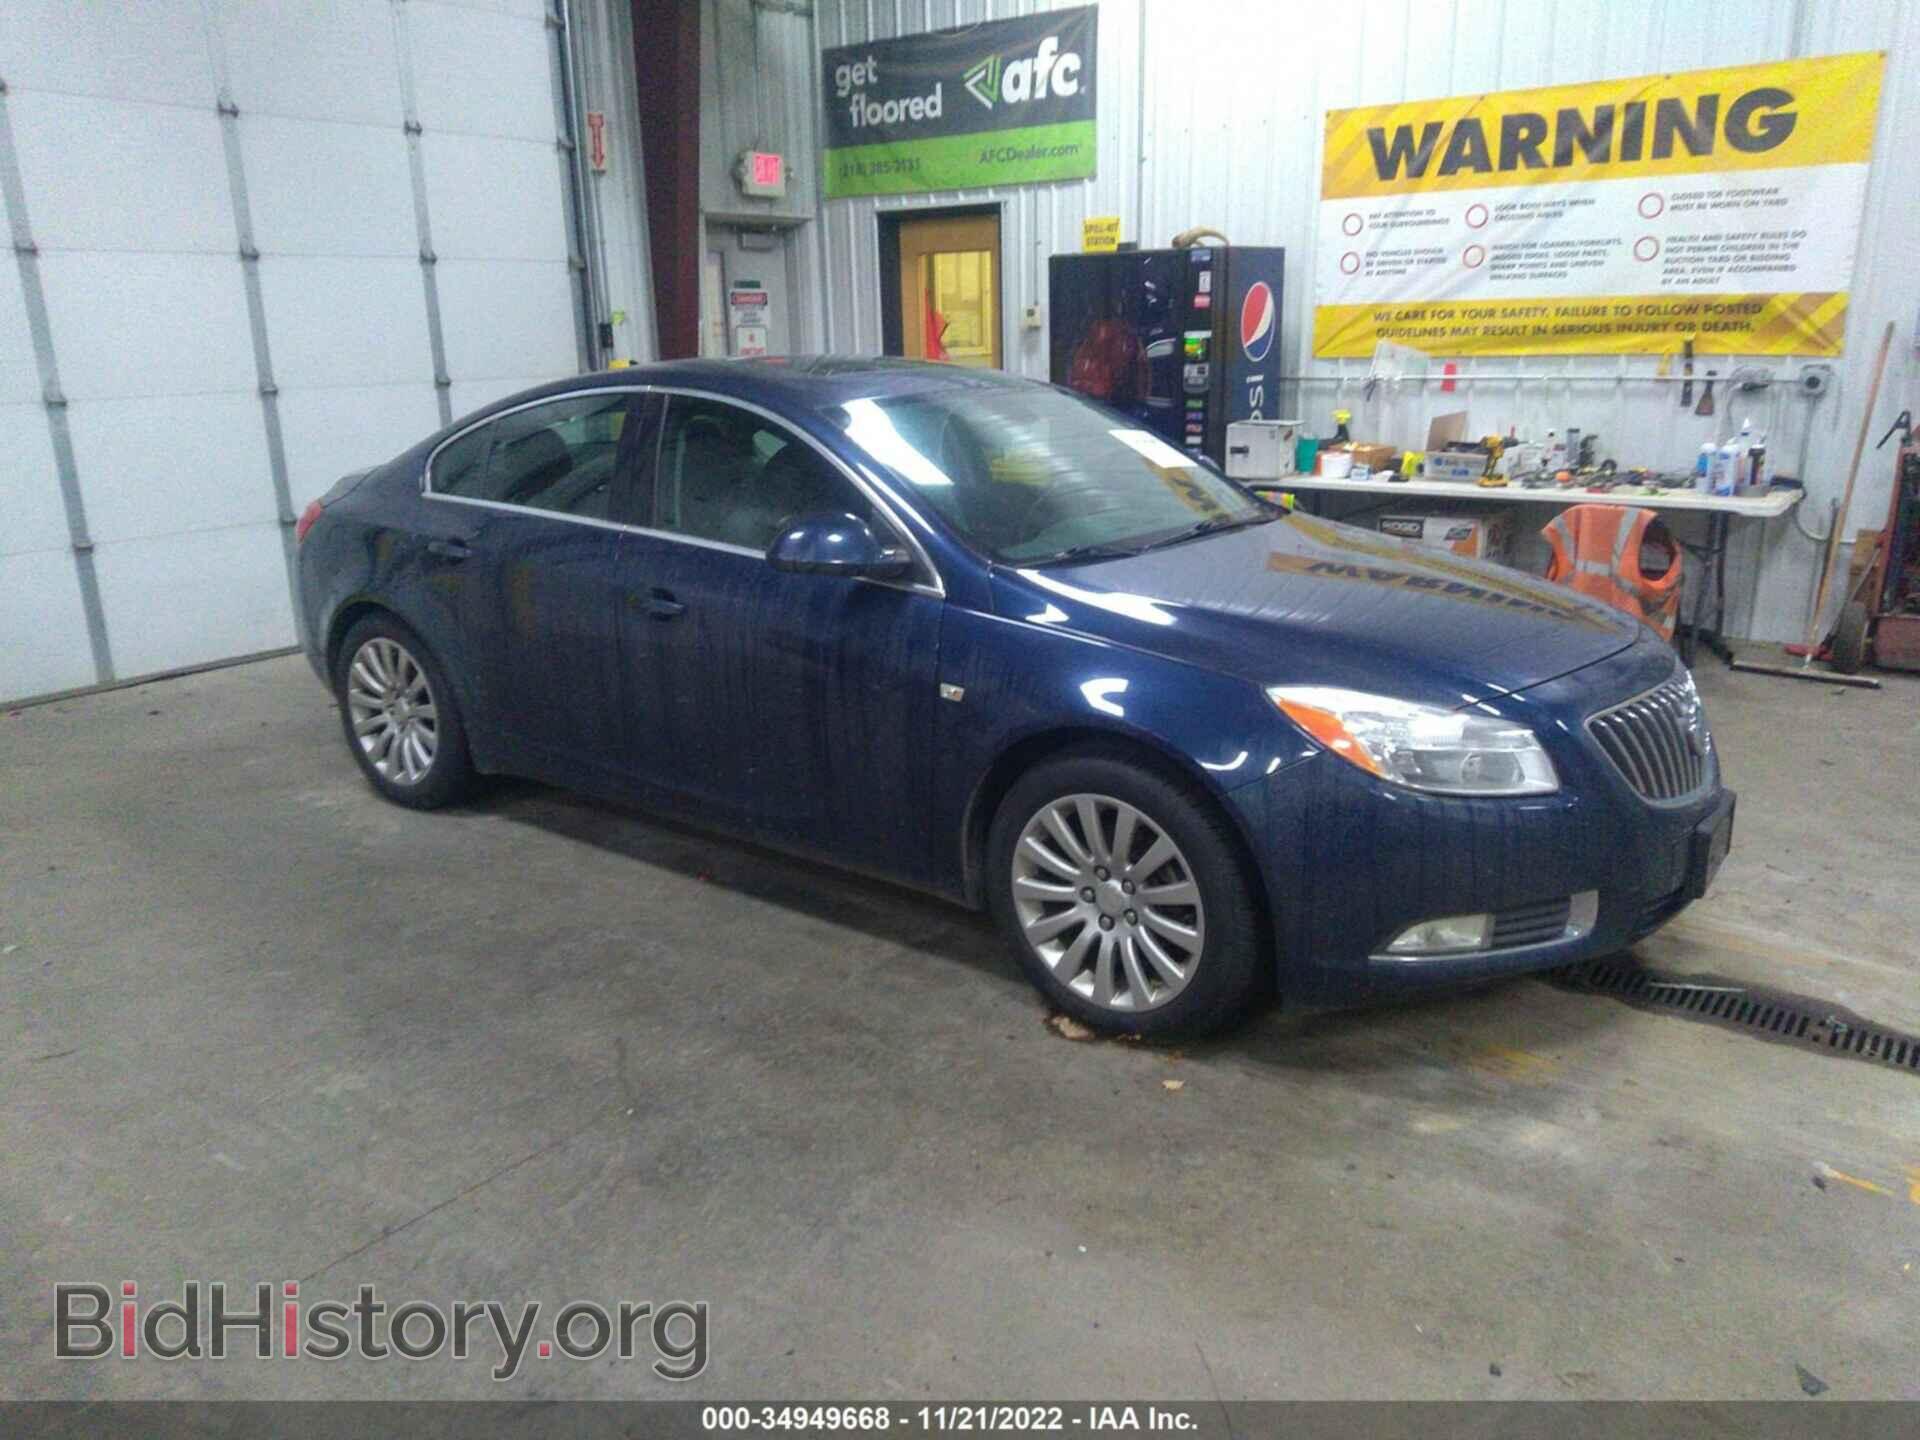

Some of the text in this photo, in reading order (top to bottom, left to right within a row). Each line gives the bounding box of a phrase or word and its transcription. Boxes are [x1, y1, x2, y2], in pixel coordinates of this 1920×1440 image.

[834, 55, 878, 96] get
[1001, 36, 1082, 104] afc
[849, 82, 943, 128] floored
[1367, 86, 1799, 181] WARNING
[1720, 242, 1766, 253] CHILDREN
[1374, 311, 1391, 321] WE
[1394, 309, 1426, 321] CARE
[1430, 309, 1456, 320] FOR
[1461, 308, 1497, 320] YOUR
[1554, 304, 1608, 318] FAILURE
[1613, 304, 1632, 317] TO
[1636, 303, 1699, 317] FOLLOW
[1703, 302, 1763, 315] POSTED
[1376, 320, 1755, 338] GUIDELINES MAY RESULT IN SERIOUS INJURY OR DEATH.
